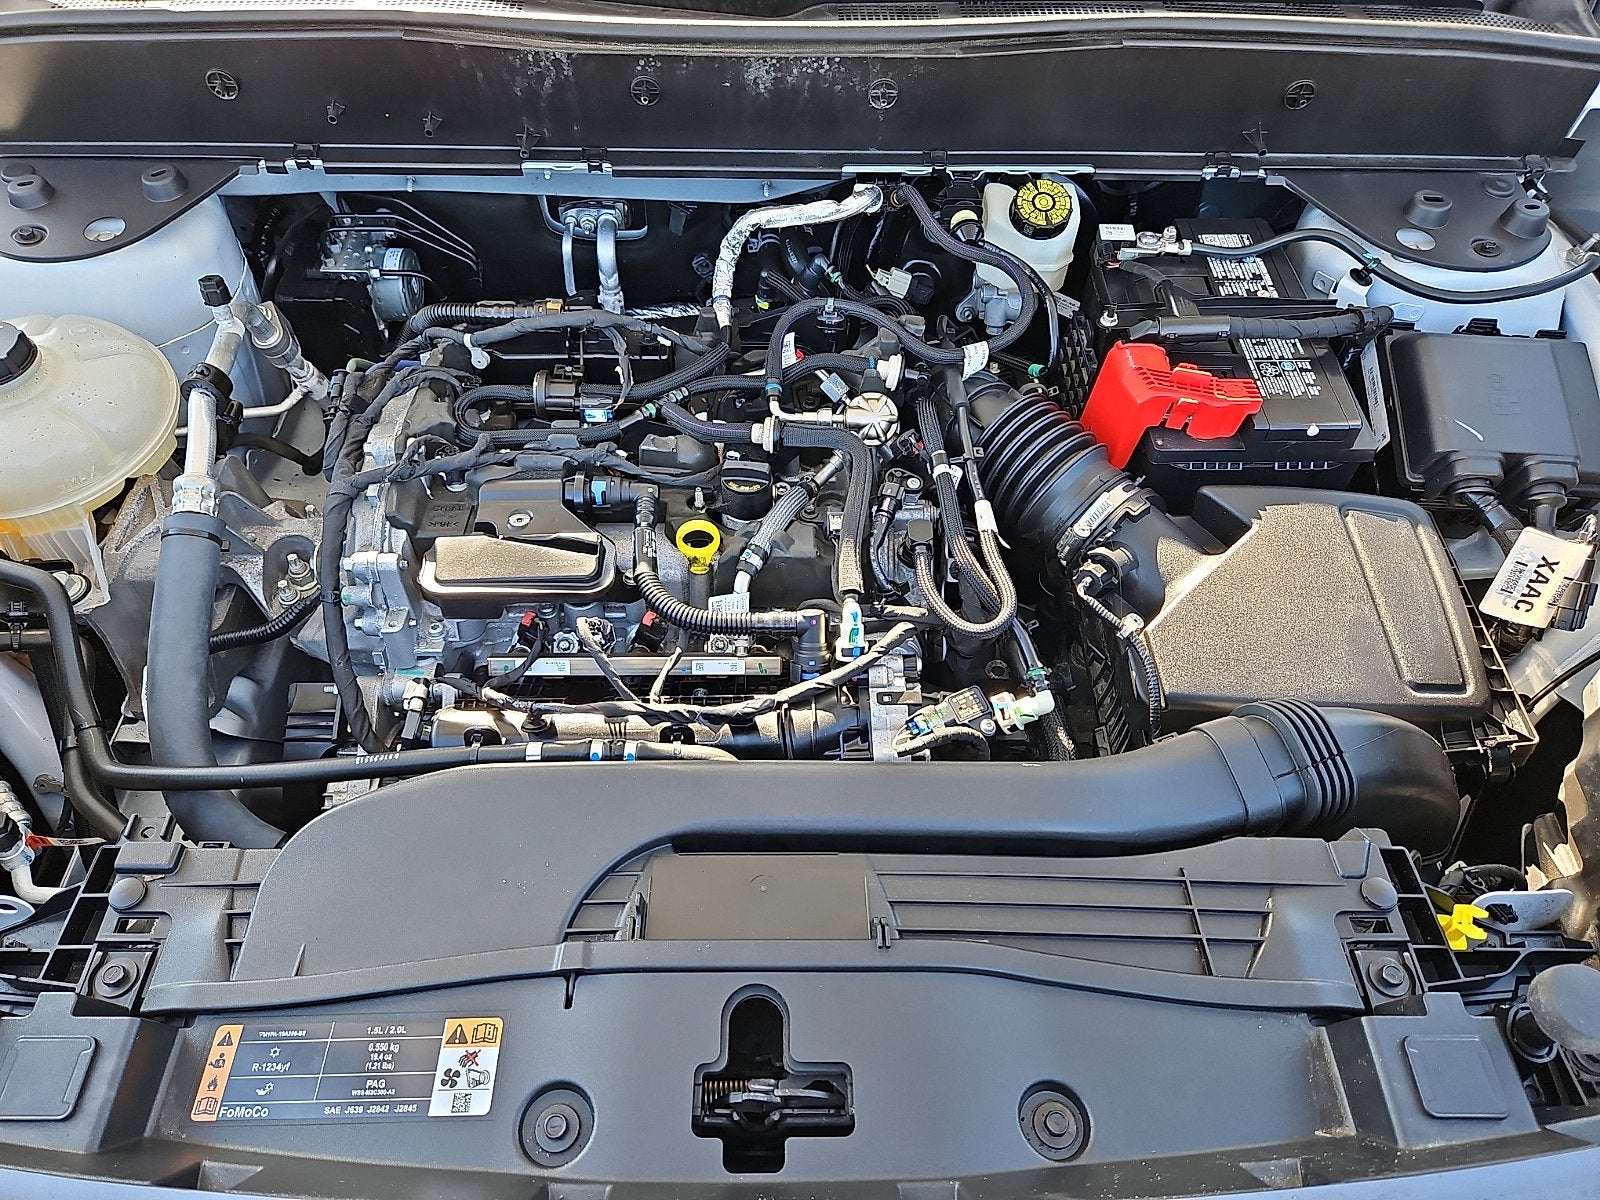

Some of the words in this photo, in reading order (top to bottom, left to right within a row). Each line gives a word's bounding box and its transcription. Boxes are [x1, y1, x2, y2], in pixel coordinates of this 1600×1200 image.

[1513, 555, 1560, 612] XAAC
[367, 1026, 383, 1035] 1.5L
[389, 1025, 407, 1034] 2.0L
[368, 1042, 389, 1052] 0.550
[389, 1042, 400, 1053] kg
[251, 1061, 291, 1073] R-1234yf
[365, 1079, 386, 1089] PAG
[218, 1105, 270, 1118] FoMoCo
[323, 1106, 342, 1115] SAE
[344, 1105, 364, 1114] J639
[366, 1104, 390, 1114] J2842
[393, 1104, 418, 1113] J2845
